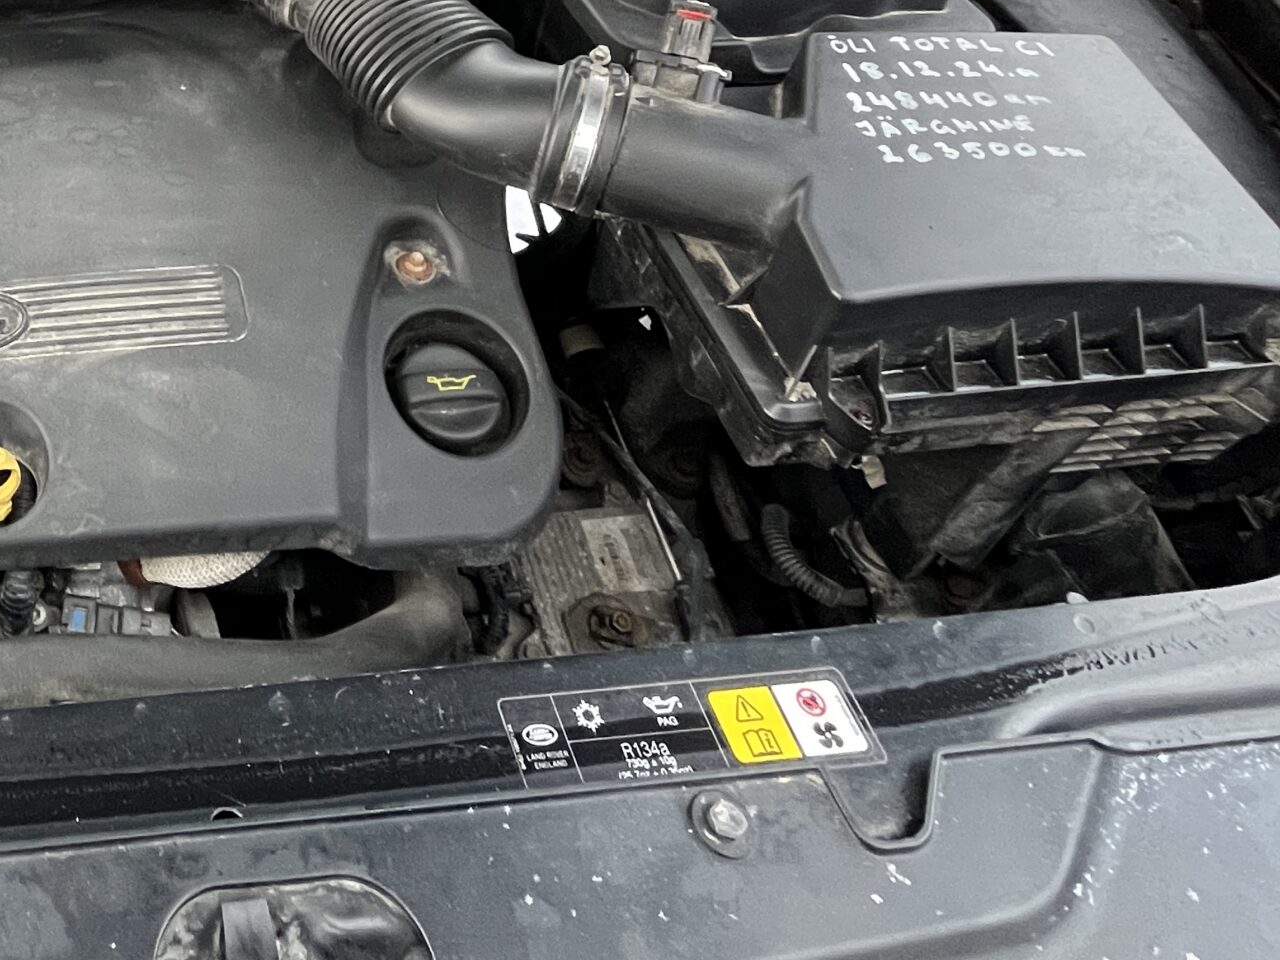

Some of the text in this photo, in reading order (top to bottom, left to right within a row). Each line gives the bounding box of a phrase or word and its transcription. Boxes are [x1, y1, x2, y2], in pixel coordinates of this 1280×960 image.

[889, 36, 1004, 53] TOTAL
[877, 141, 1038, 163] 263500
[656, 715, 680, 727] PAG
[525, 751, 546, 762] LAND
[620, 740, 671, 759] R134a
[534, 759, 568, 770] ENGLAND
